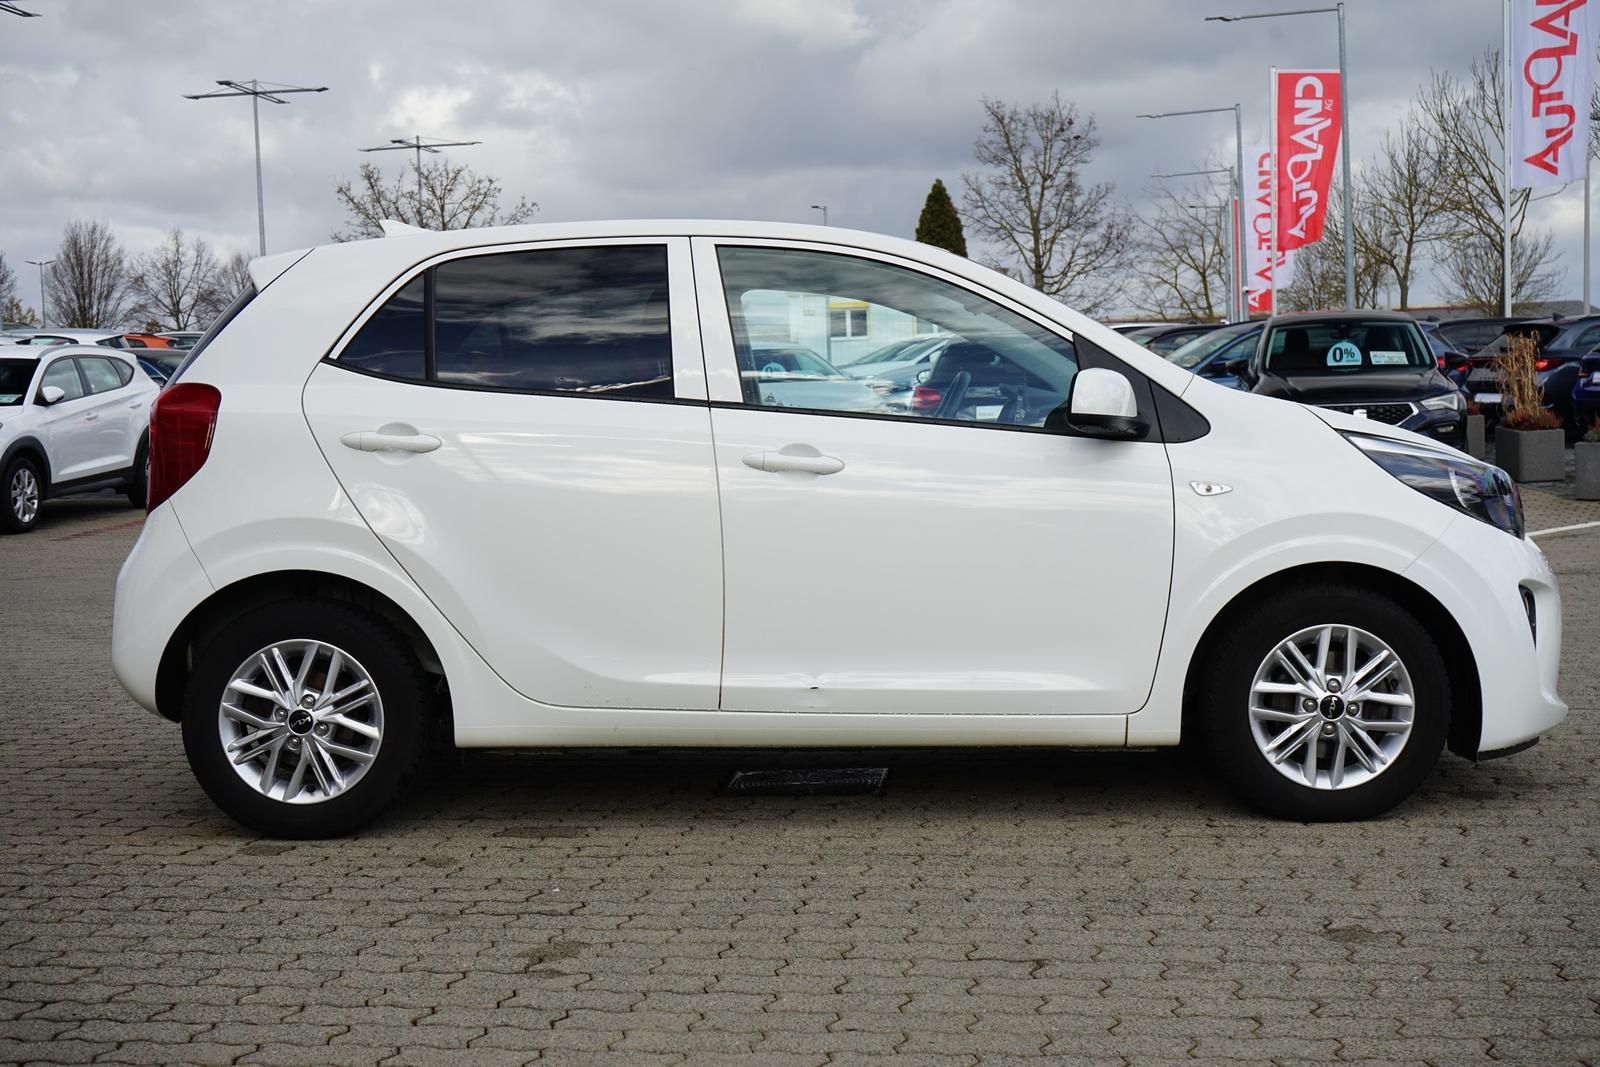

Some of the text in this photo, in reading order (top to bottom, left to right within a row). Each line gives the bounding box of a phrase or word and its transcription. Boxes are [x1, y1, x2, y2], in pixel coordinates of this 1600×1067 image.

[1324, 98, 1334, 112] AG
[1523, 0, 1587, 176] AUTOLA
[1287, 76, 1332, 239] AUTOLAND
[1332, 346, 1356, 363] 0%
